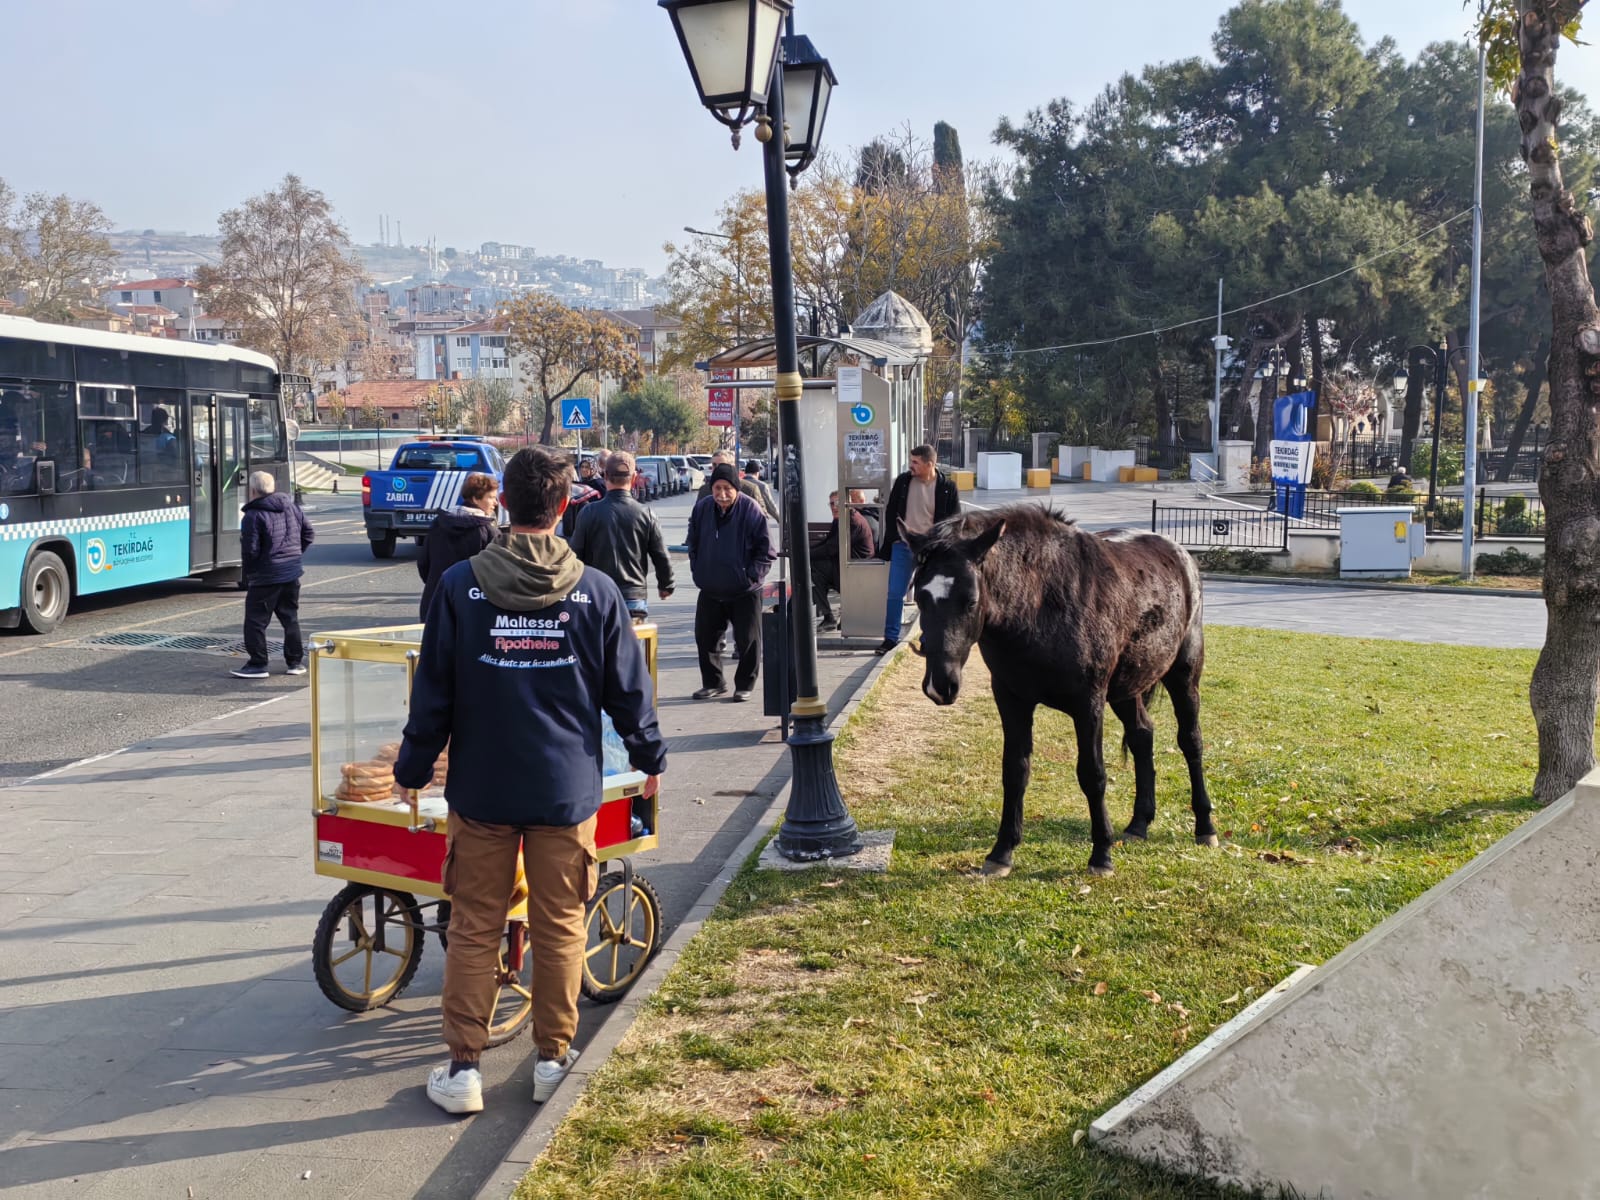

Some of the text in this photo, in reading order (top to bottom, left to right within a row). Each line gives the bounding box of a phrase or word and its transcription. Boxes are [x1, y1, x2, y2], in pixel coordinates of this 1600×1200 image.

[386, 492, 415, 502] ZABITA
[112, 537, 153, 556] TEKİRDAĞ
[571, 590, 592, 603] da.
[495, 615, 561, 629] Malteser
[495, 637, 560, 652] Apotheke
